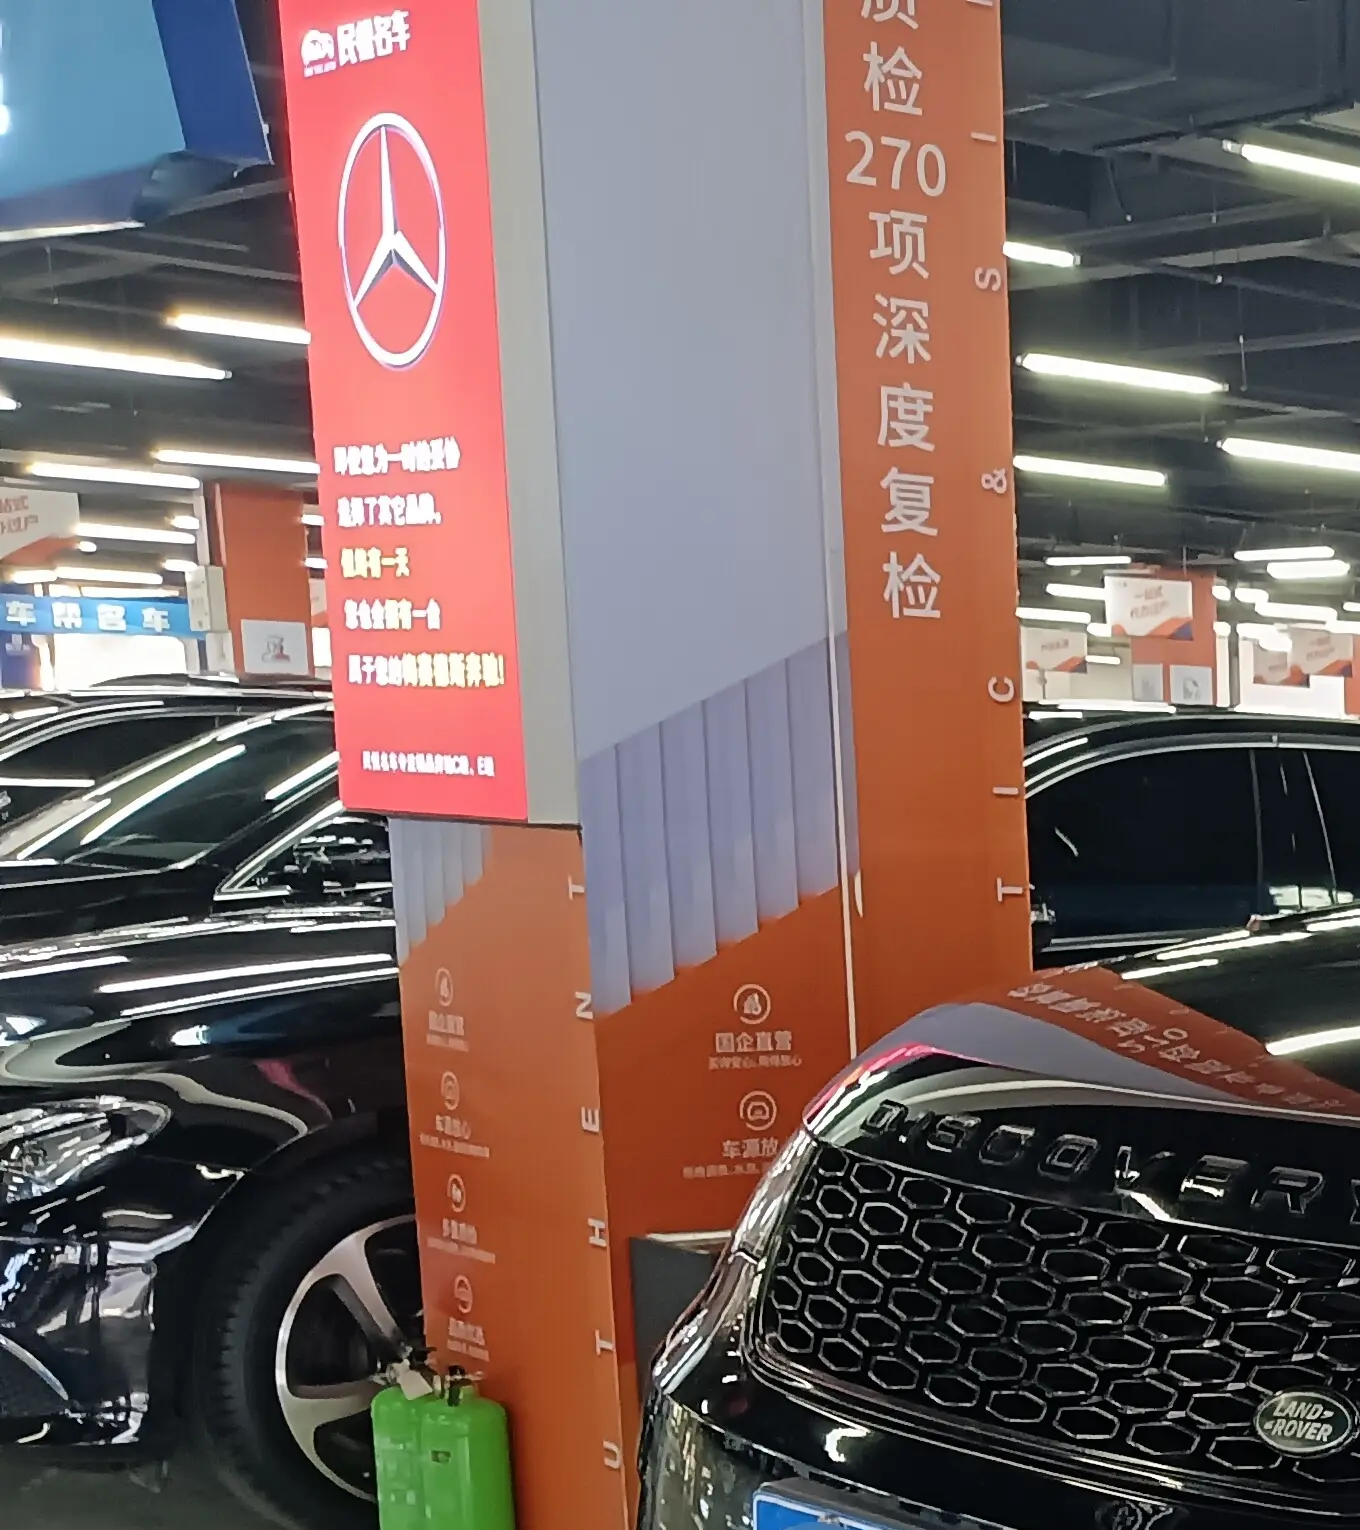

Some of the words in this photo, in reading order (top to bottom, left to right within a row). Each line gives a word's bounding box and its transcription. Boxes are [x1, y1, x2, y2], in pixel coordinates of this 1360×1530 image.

[715, 1031, 793, 1054] 国企直营
[1273, 1400, 1325, 1421] LAND
[1270, 1418, 1334, 1443] ROVER
